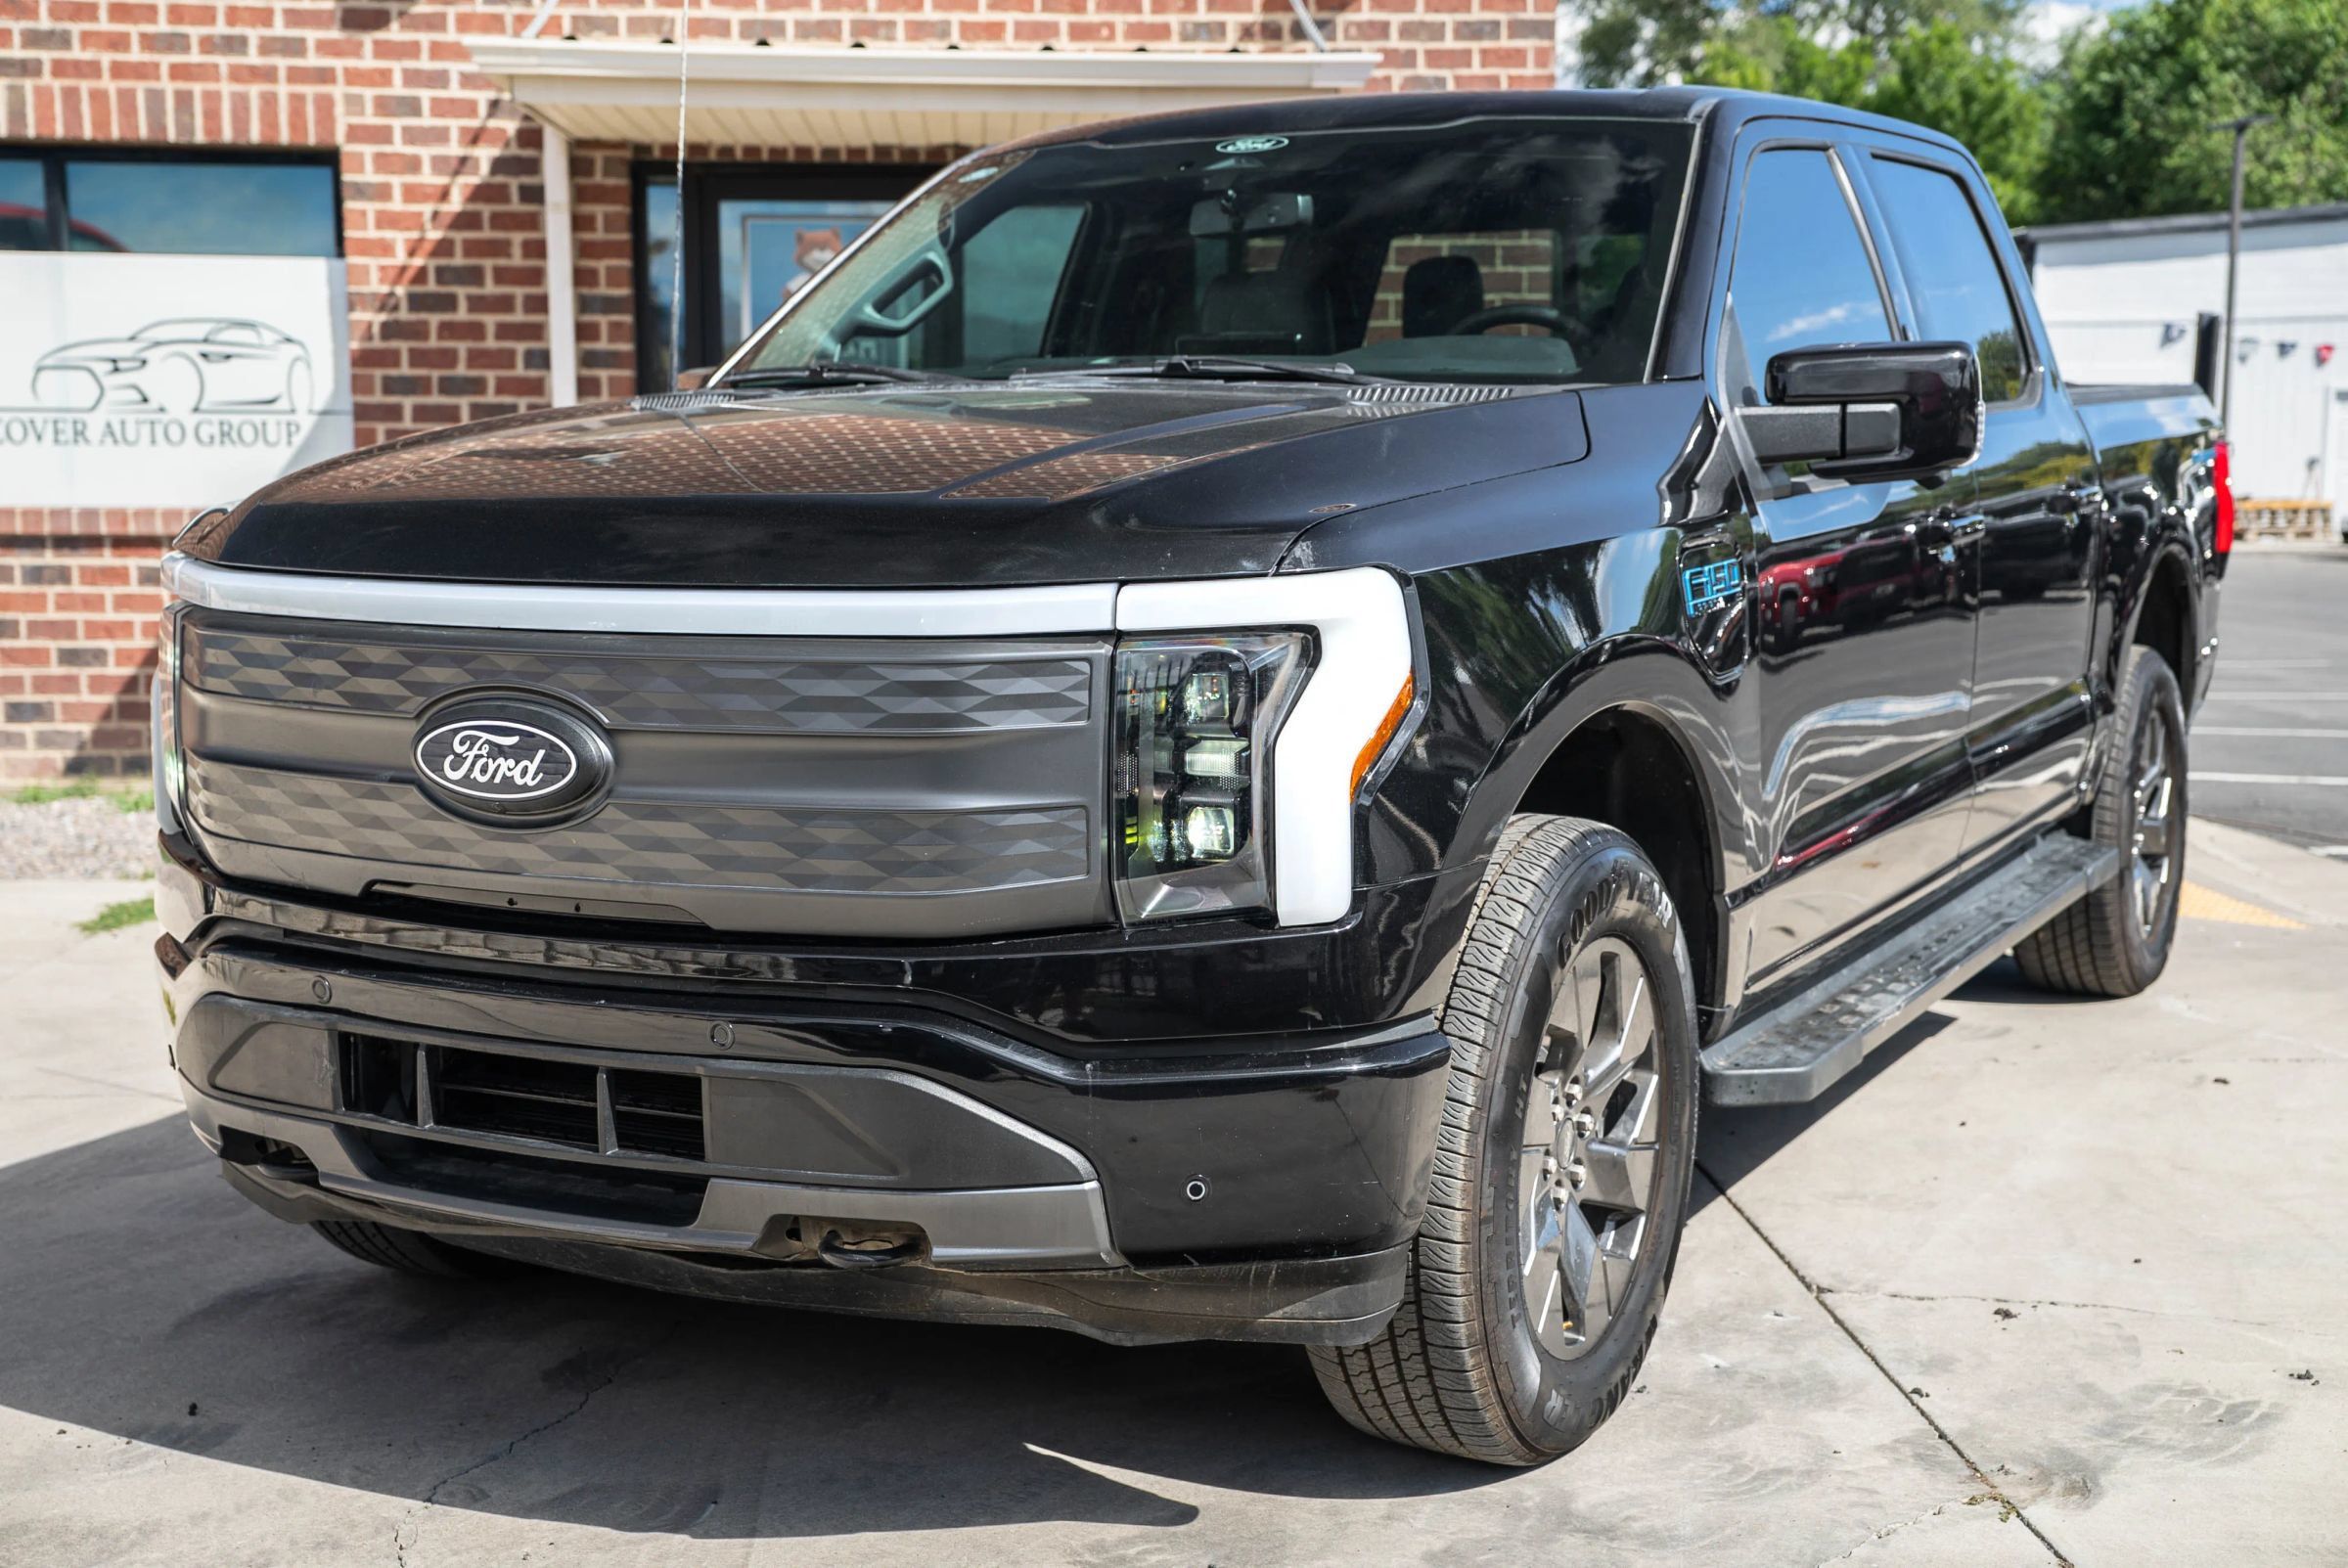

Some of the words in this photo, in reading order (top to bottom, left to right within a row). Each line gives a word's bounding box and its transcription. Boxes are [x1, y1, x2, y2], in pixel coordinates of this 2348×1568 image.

[0, 417, 91, 446] OVER
[100, 418, 186, 447] AUTO
[196, 420, 301, 448] GROUP
[443, 730, 546, 786] Ford
